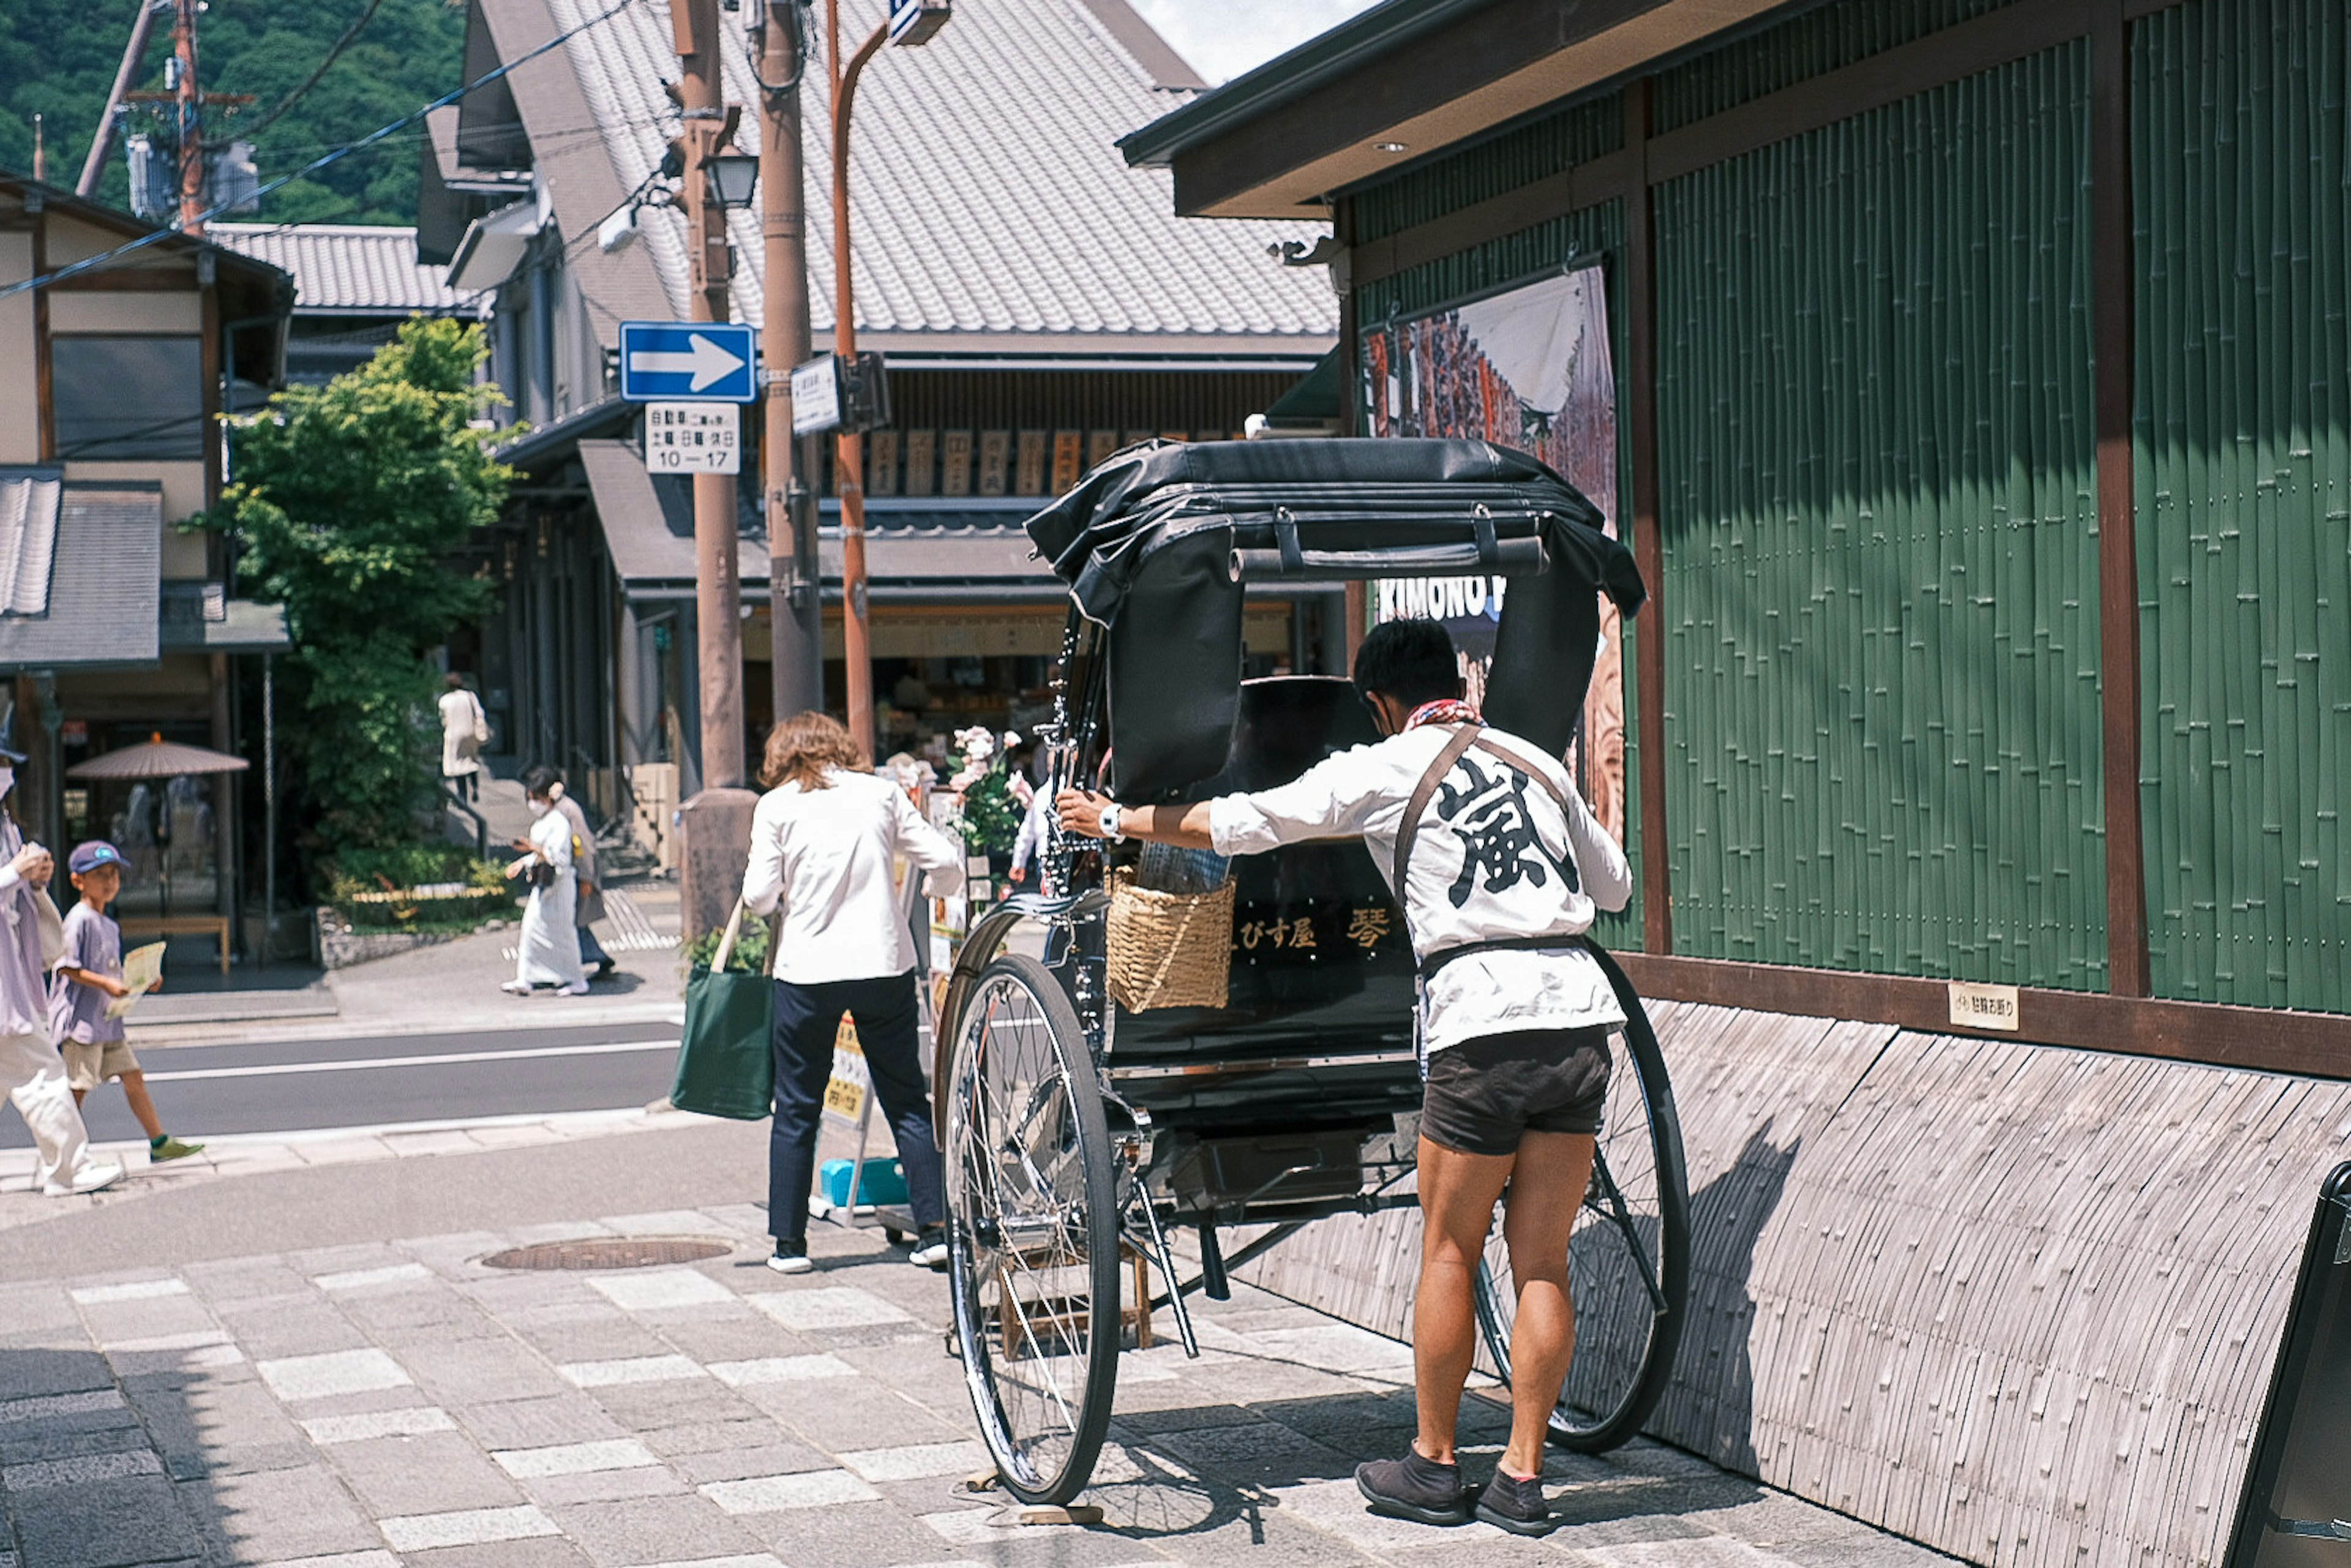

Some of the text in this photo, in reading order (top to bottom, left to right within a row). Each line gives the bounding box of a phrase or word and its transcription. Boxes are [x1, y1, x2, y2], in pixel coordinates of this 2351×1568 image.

[1379, 576, 1487, 624] KIMONO
[1231, 908, 1390, 951] びす屋 琴
